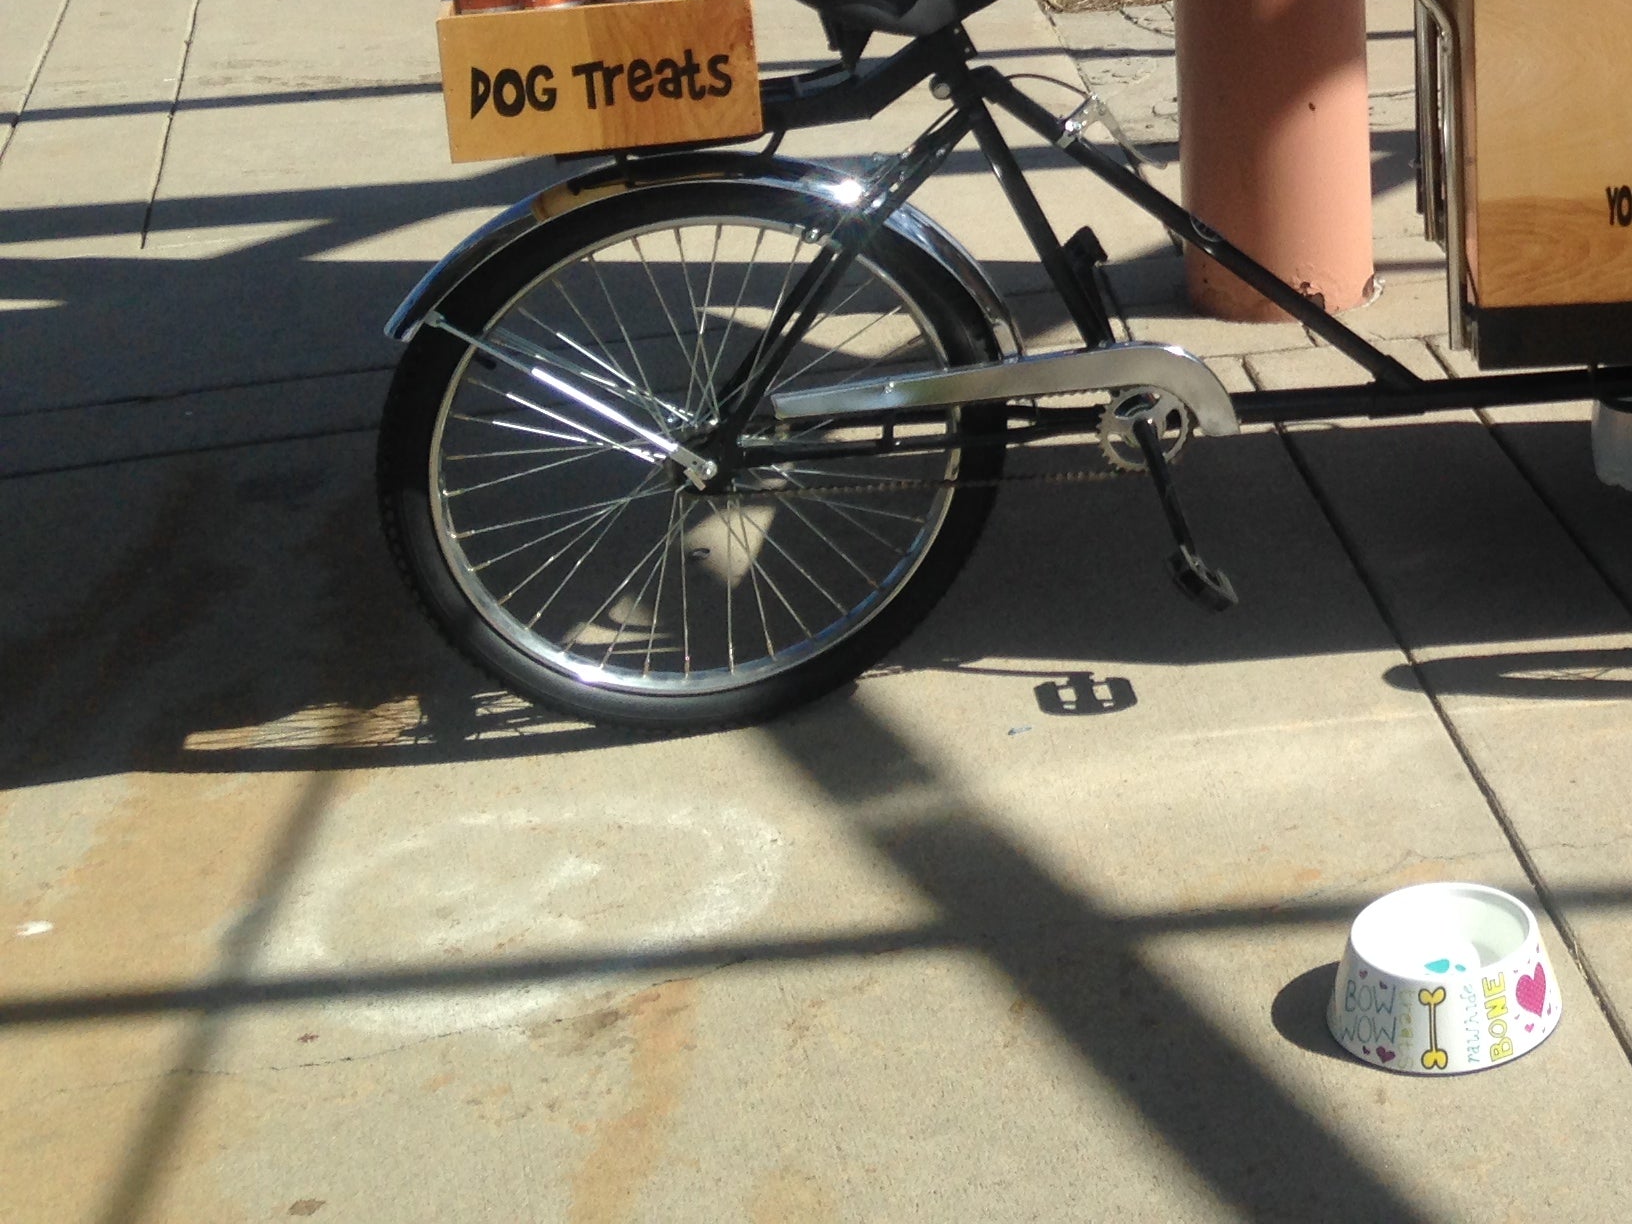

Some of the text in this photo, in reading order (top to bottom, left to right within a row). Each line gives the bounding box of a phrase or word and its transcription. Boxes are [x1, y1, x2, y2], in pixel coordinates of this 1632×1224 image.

[572, 48, 733, 110] Treats
[1344, 979, 1396, 1015] BOW
[1482, 971, 1514, 1063] BONE
[1339, 1015, 1397, 1044] WOW
